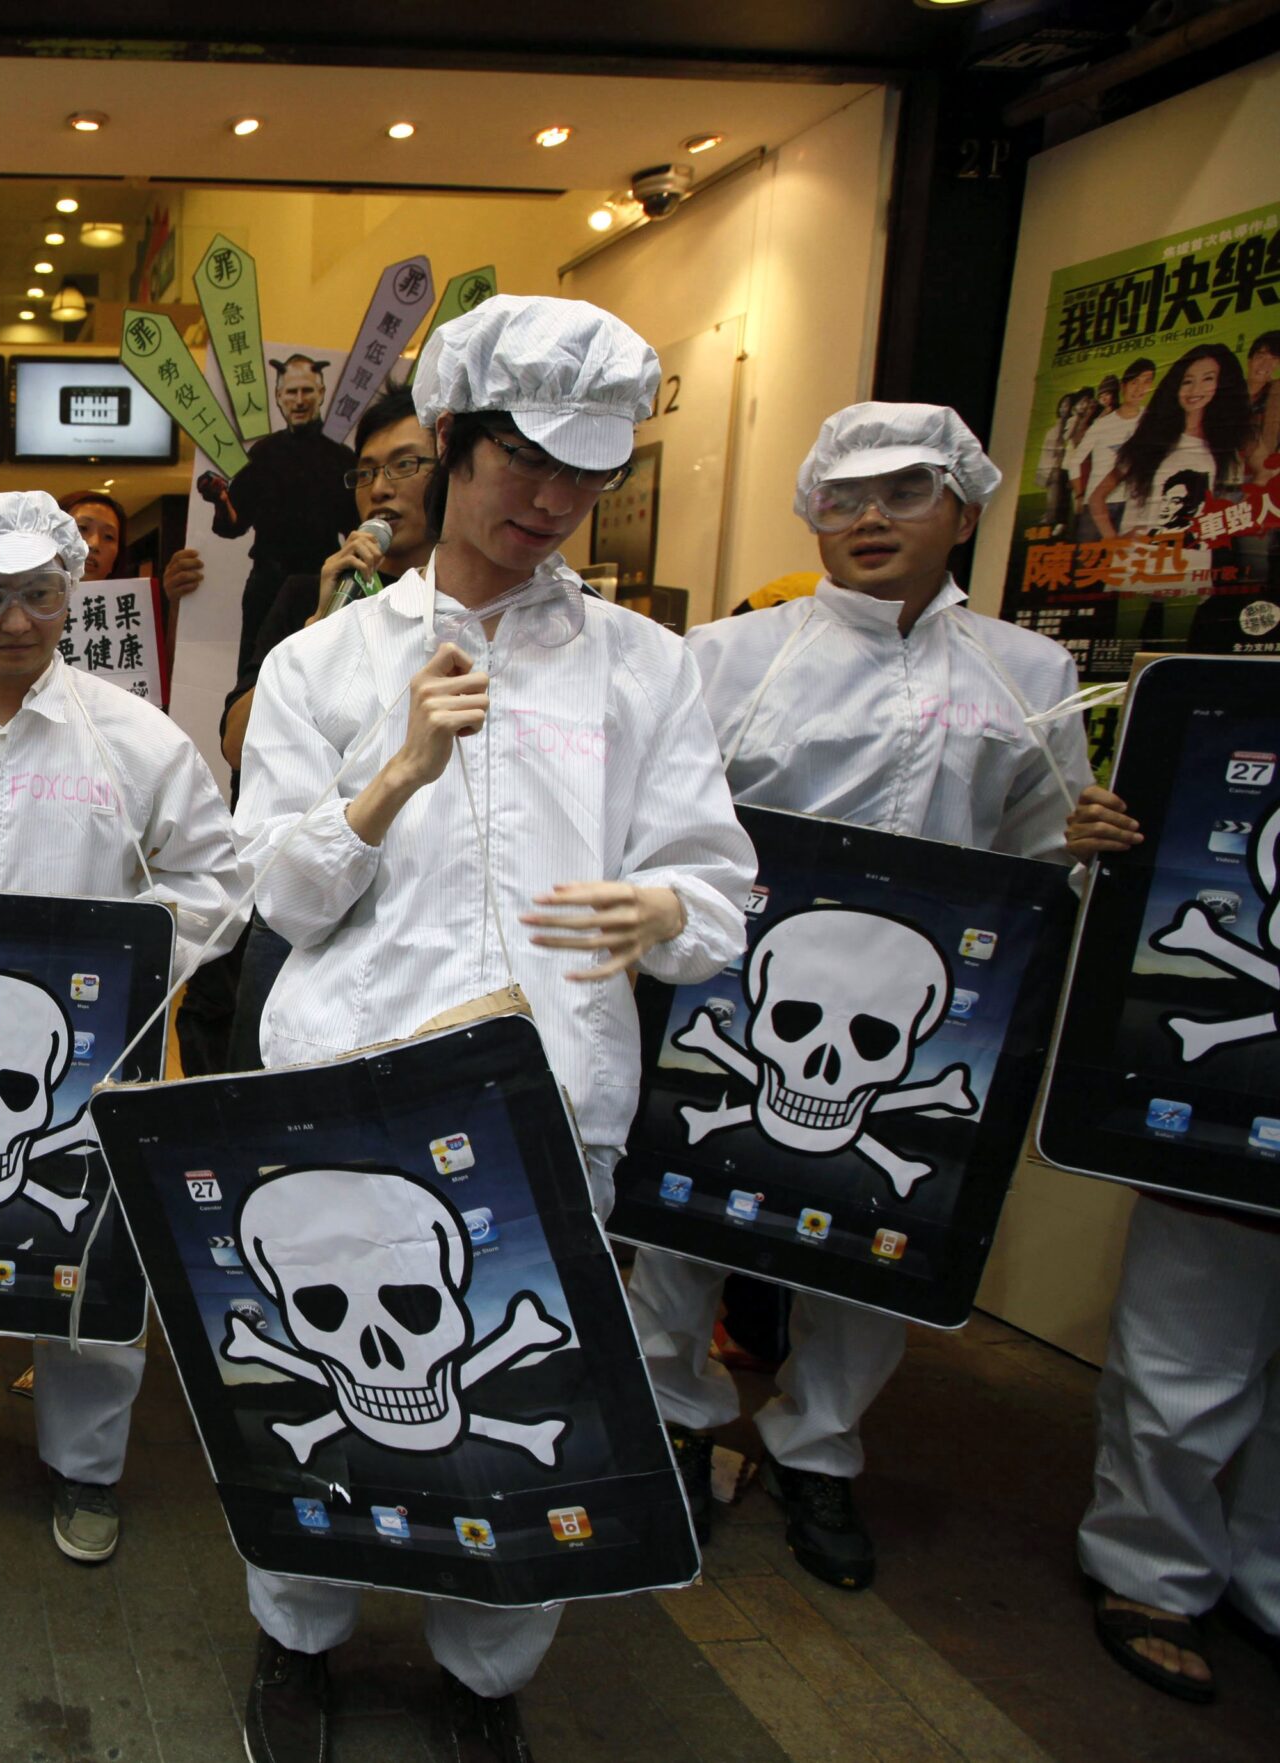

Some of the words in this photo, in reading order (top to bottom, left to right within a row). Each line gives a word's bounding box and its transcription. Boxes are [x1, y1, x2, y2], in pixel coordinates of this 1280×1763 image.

[212, 249, 238, 281] 罪
[398, 265, 425, 297] 罪
[1055, 231, 1280, 352] 我的快樂
[128, 320, 158, 352] 罪
[220, 301, 263, 416] 急單逼人
[1022, 532, 1191, 594] 陳奕迅
[1230, 762, 1270, 782] 27
[302, 1122, 315, 1131] AM
[191, 1180, 216, 1199] 27
[451, 1174, 470, 1183] Maps
